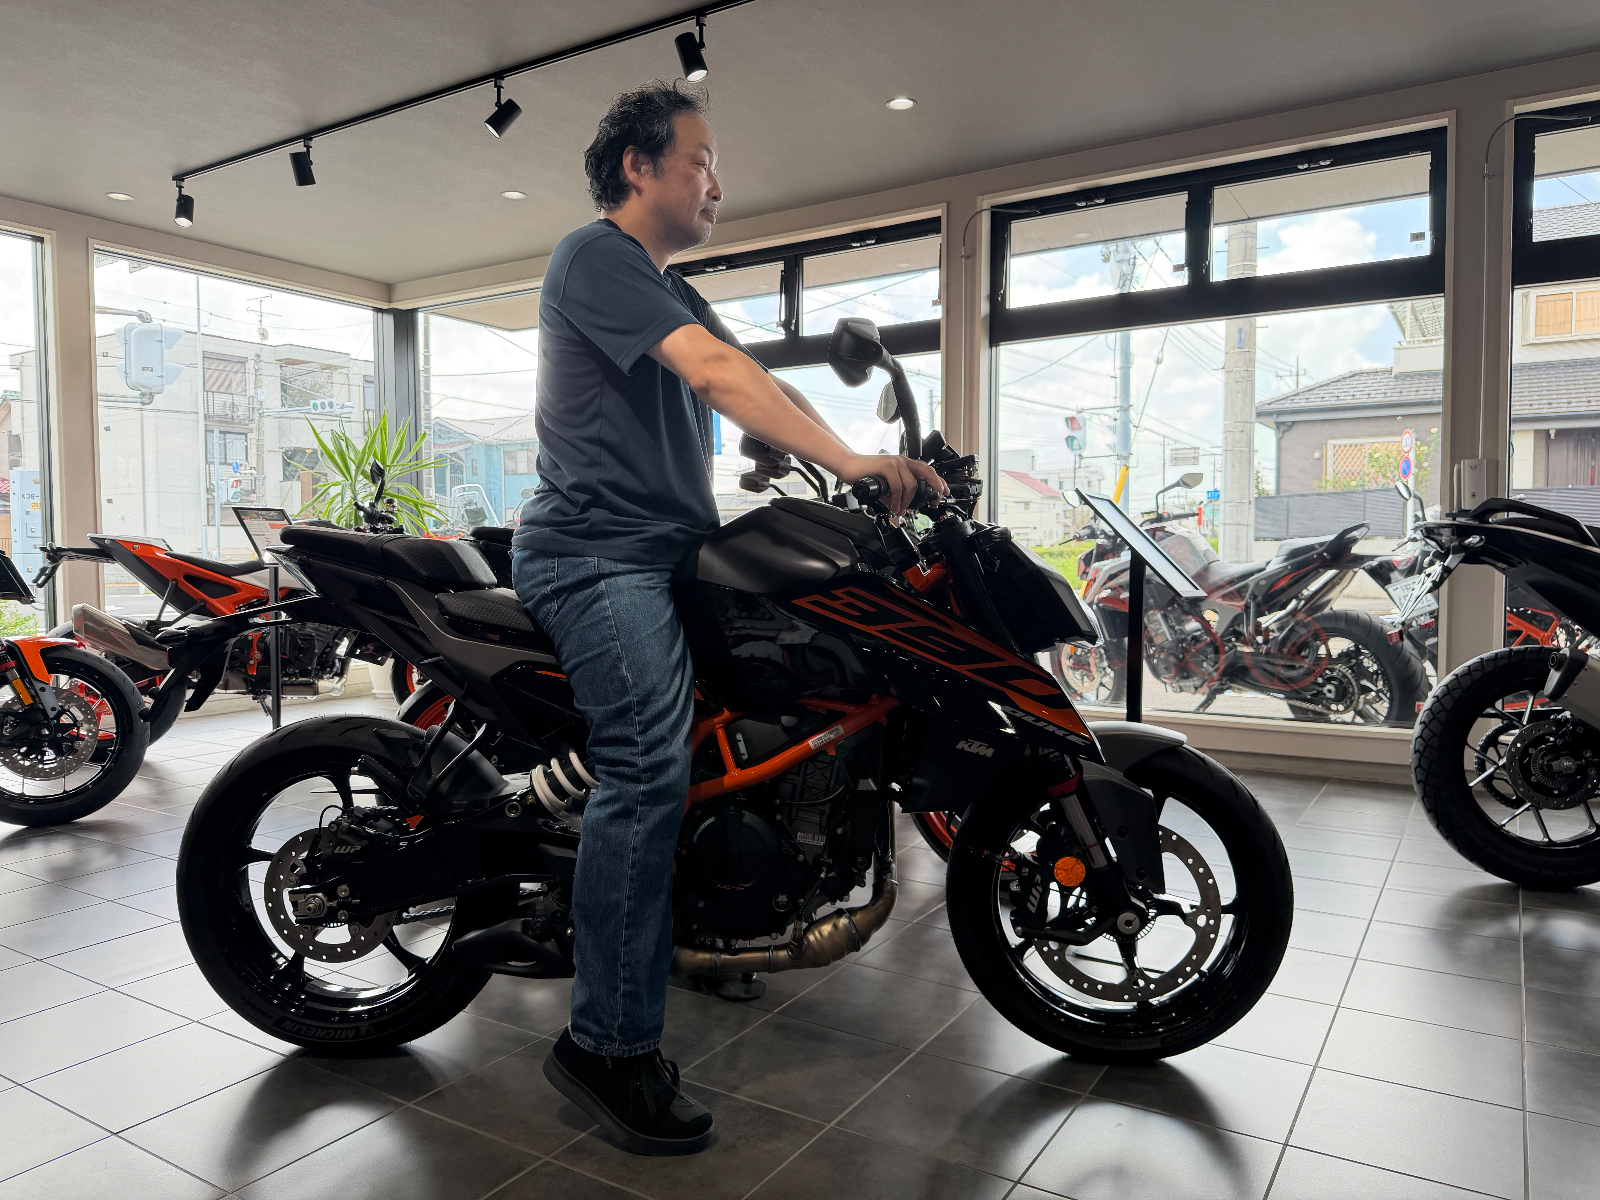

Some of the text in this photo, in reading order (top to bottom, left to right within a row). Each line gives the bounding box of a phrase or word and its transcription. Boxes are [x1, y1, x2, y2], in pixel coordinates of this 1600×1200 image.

[1001, 704, 1091, 746] DUKE
[956, 739, 995, 758] KTM
[334, 846, 361, 854] WP
[1026, 873, 1042, 914] WP
[280, 1019, 356, 1040] MICHELIN
[1164, 1017, 1211, 1045] MICHELIN
